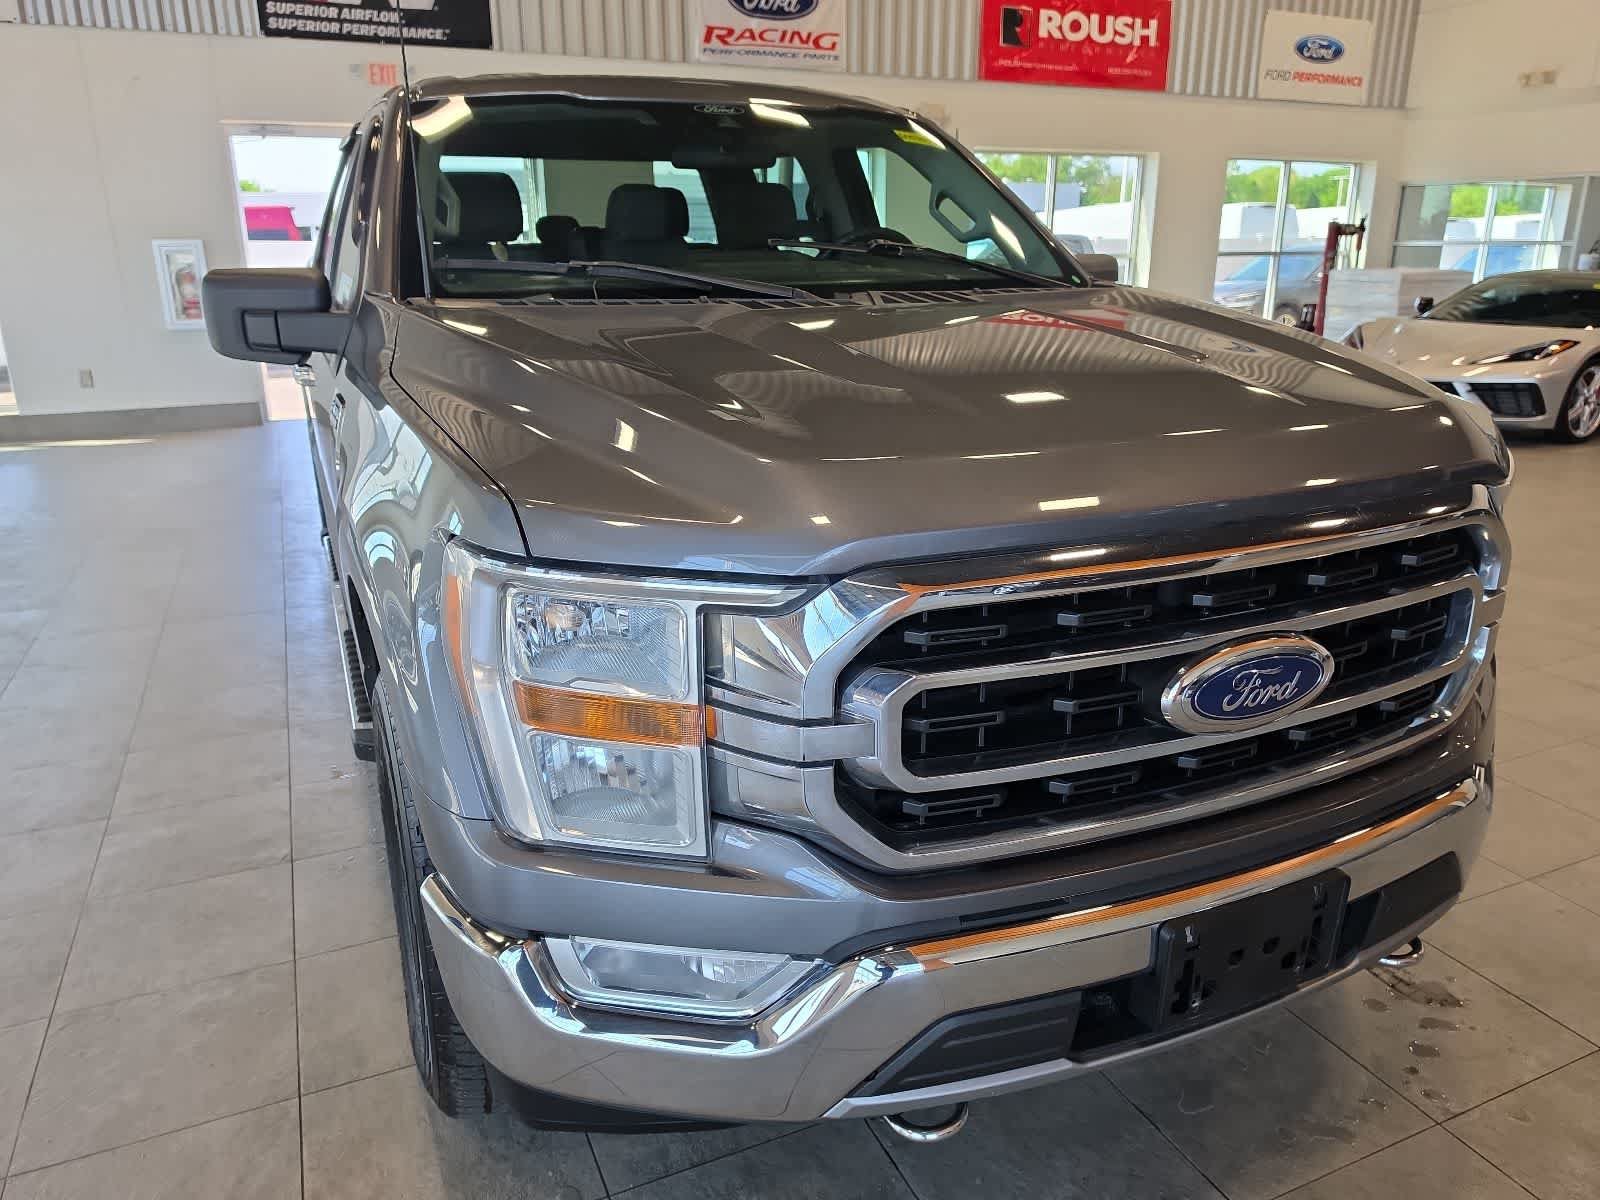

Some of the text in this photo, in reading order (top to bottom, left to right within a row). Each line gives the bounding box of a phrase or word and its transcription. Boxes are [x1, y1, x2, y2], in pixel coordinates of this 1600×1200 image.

[265, 1, 338, 19] SUPERIOR
[267, 17, 340, 34] SUPERIOR
[1037, 8, 1159, 48] ROUSH
[703, 25, 840, 51] RACING
[703, 47, 840, 61] PERFORMANCE PARTS
[1302, 39, 1337, 59] Ford
[369, 63, 396, 85] EXIT
[1264, 69, 1363, 88] FORD PERFORMANCE
[703, 104, 737, 114] Ford
[1222, 665, 1303, 712] Ford
